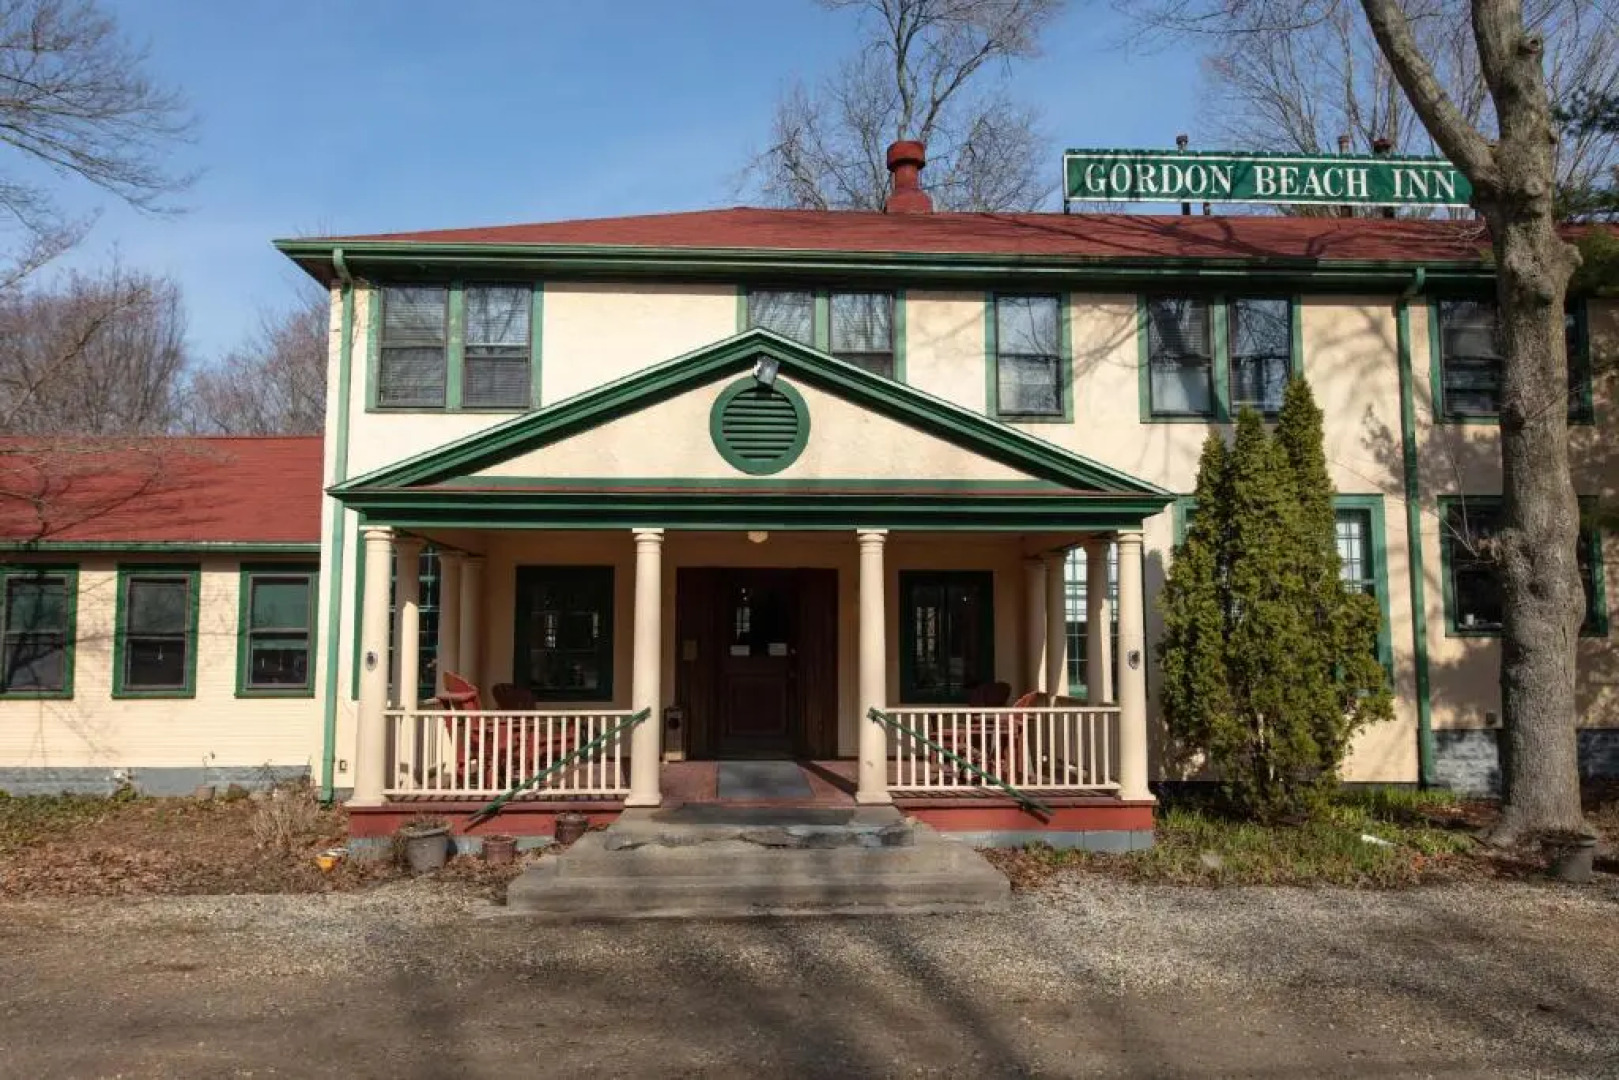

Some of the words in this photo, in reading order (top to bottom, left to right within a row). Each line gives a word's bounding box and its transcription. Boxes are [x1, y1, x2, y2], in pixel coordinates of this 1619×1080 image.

[1085, 162, 1234, 195] GORDON
[1254, 165, 1370, 198] BEACH
[1392, 168, 1456, 199] INN
